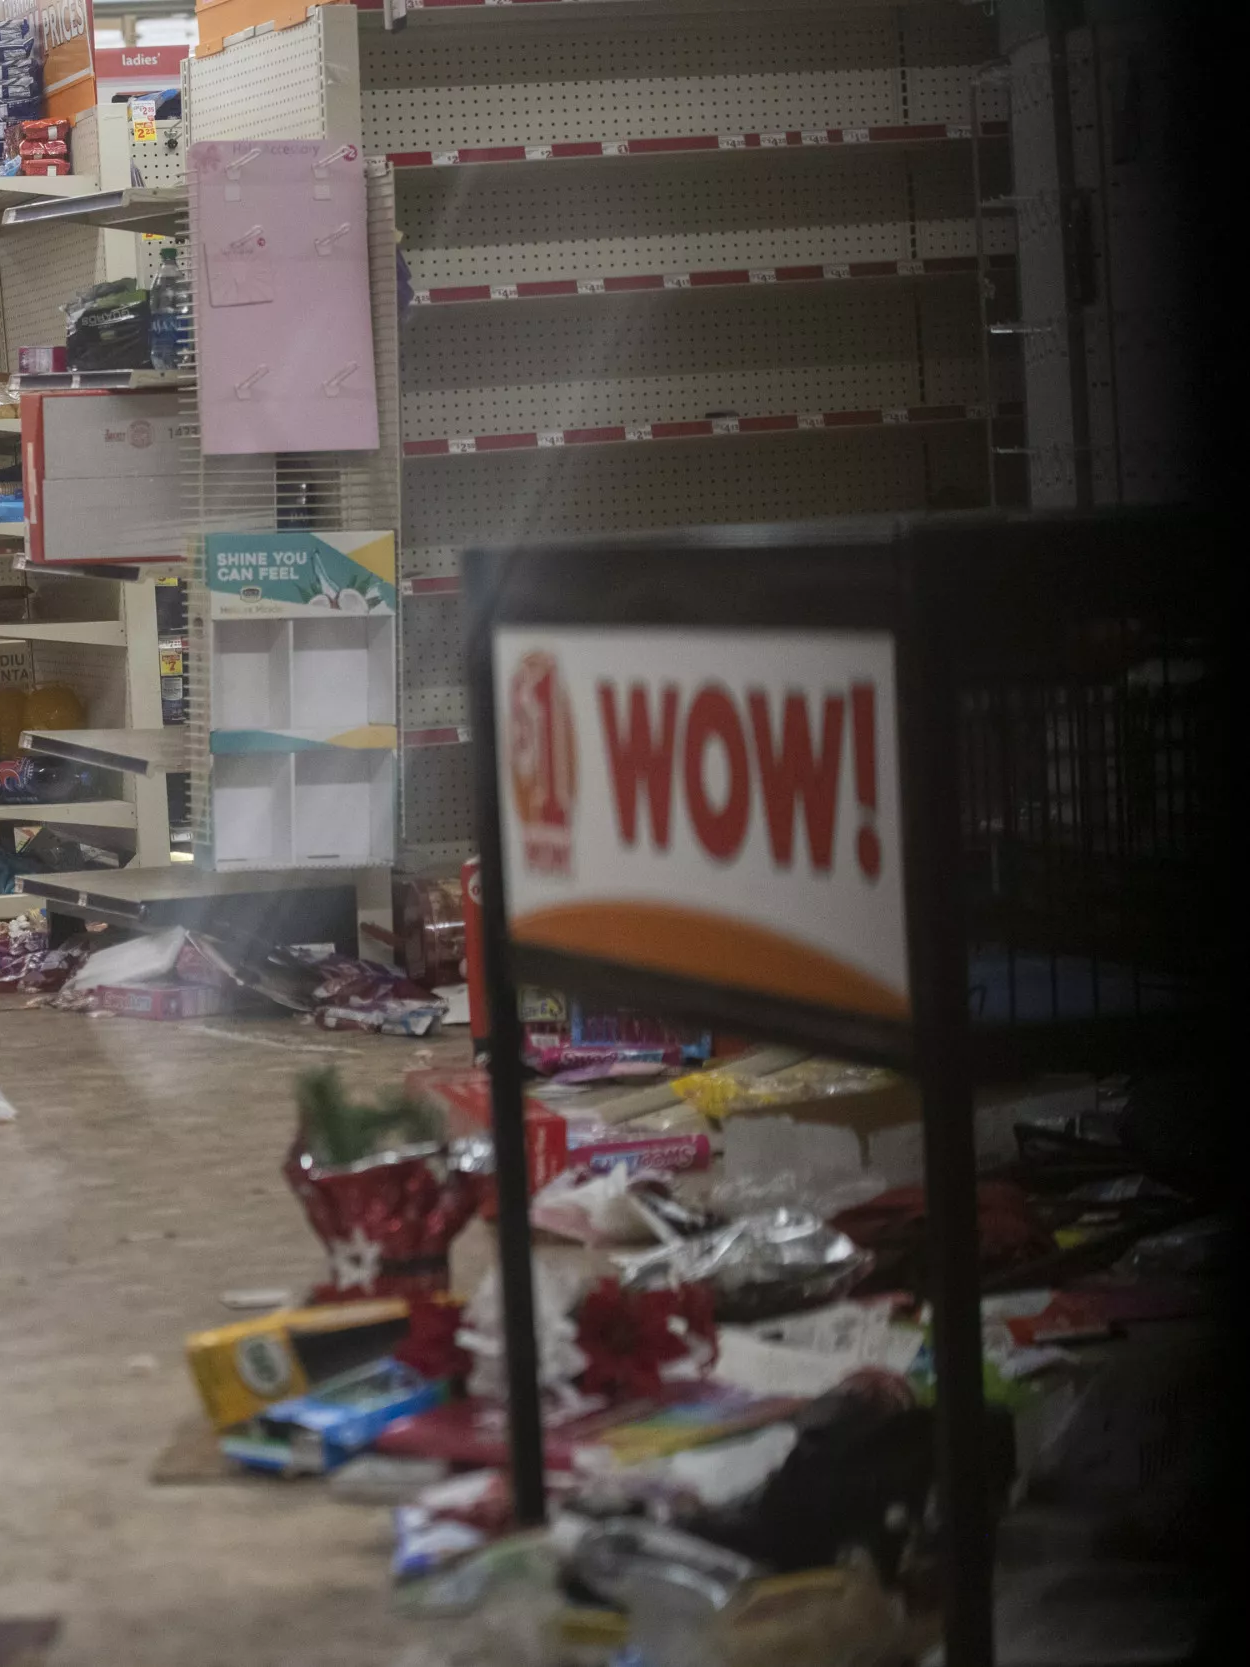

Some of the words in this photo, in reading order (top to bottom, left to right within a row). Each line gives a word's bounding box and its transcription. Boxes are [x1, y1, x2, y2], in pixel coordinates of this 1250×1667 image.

[42, 0, 85, 52] PRICES
[122, 53, 161, 66] ladies'
[216, 552, 268, 567] SHINE
[272, 551, 308, 566] YOU
[217, 567, 255, 582] CAN
[259, 565, 300, 580] FEEL
[597, 676, 882, 887] WOW!
